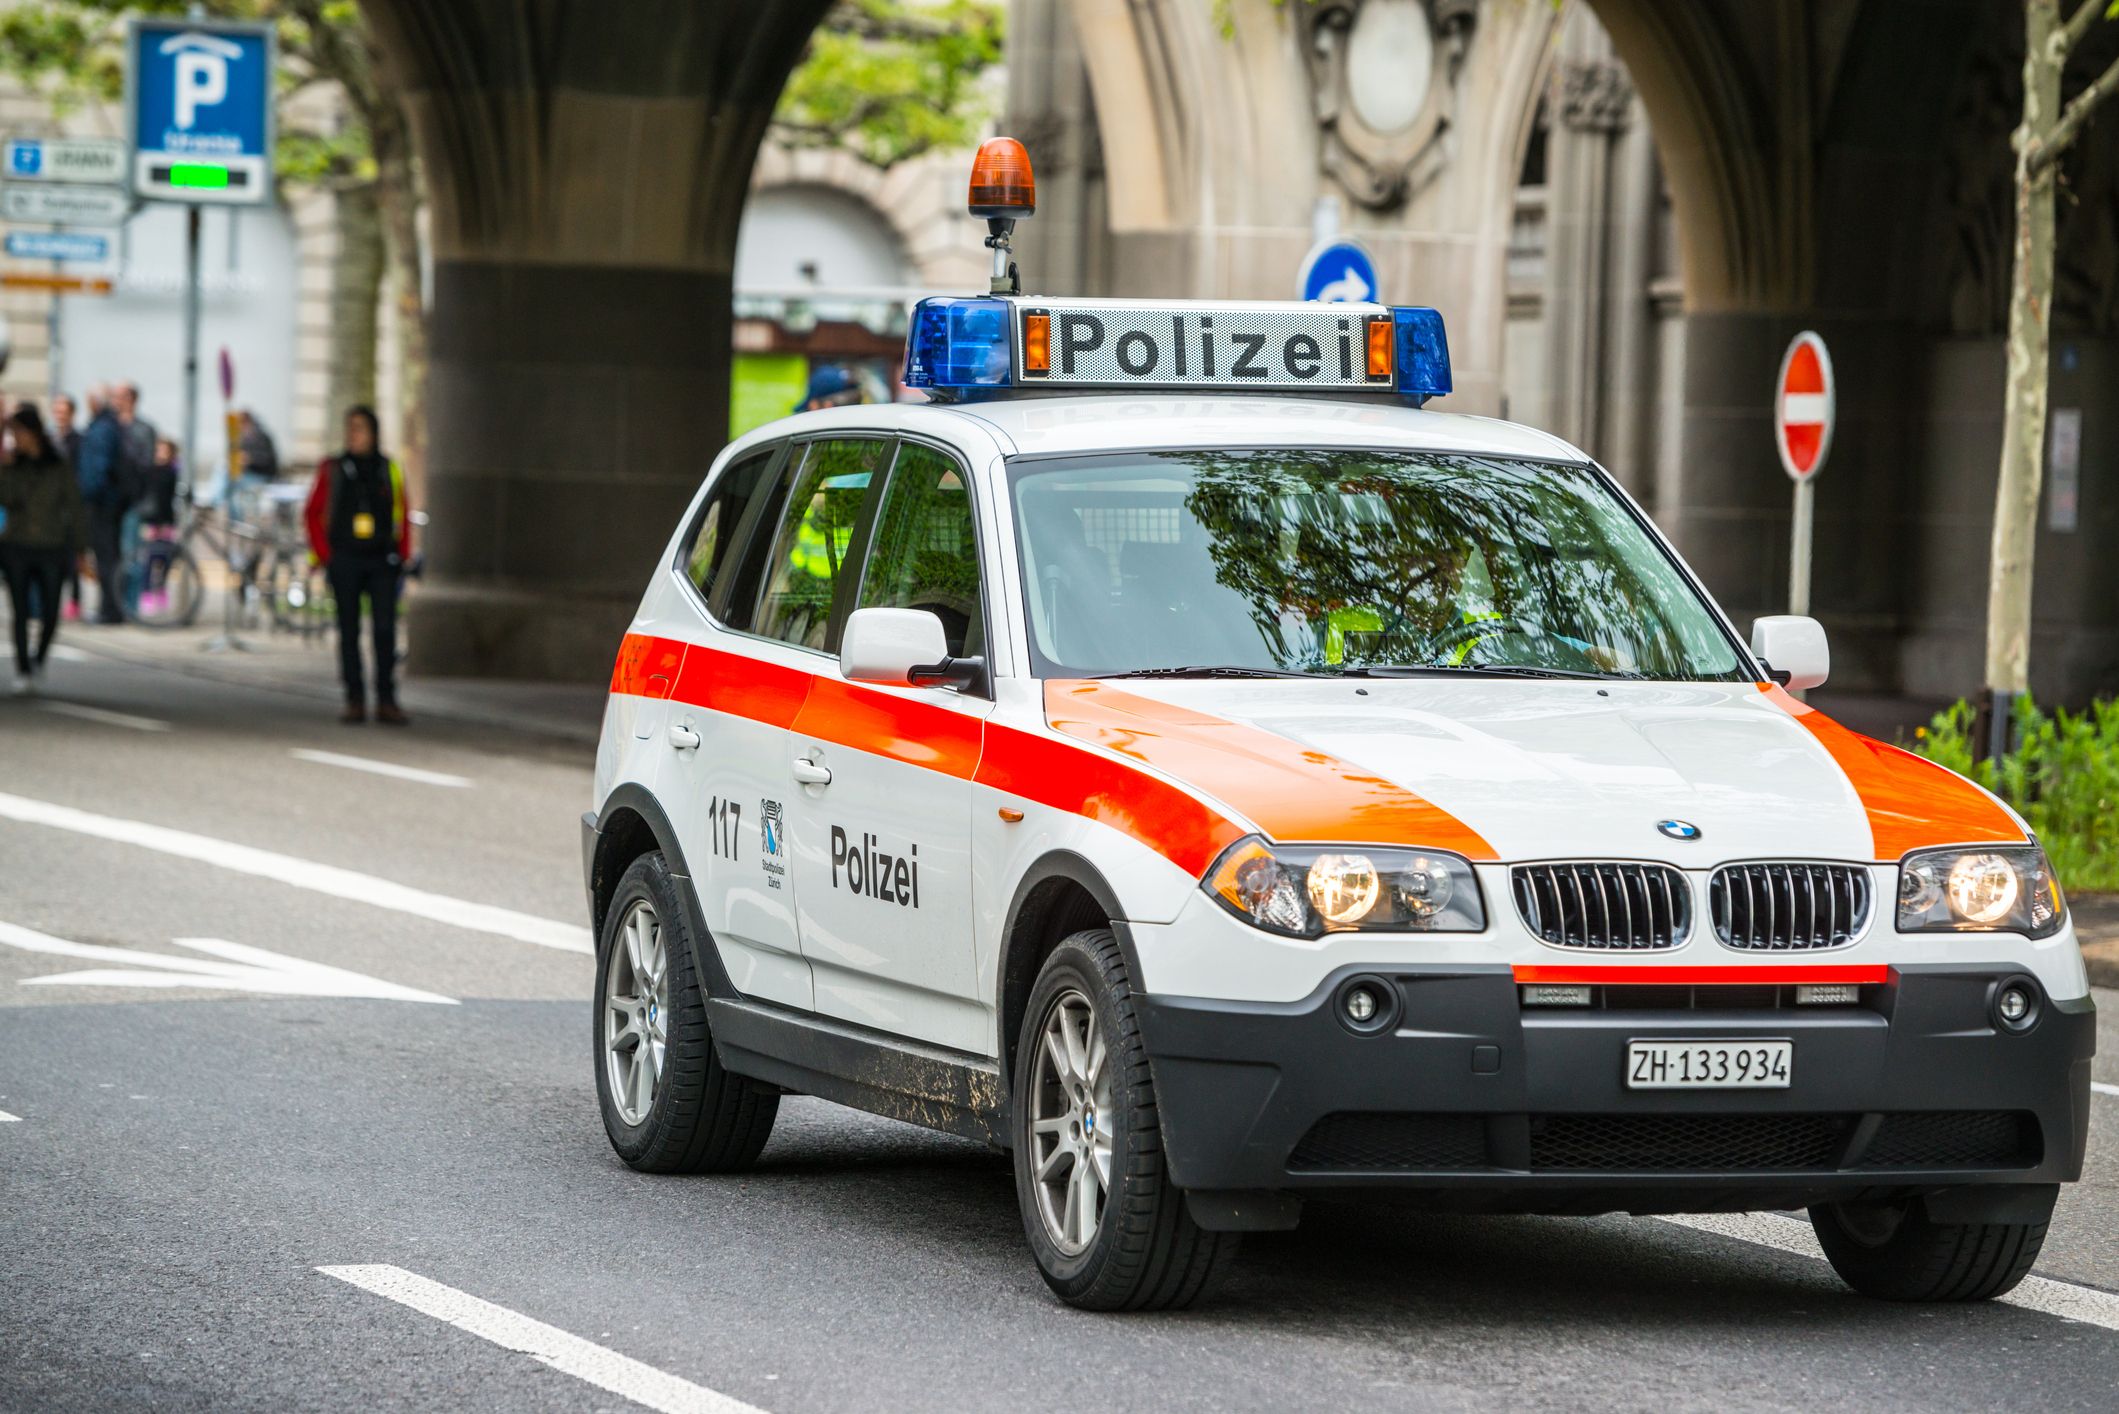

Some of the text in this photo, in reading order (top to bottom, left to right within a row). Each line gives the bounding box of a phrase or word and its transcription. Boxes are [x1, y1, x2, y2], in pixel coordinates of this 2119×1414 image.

[174, 52, 228, 130] P
[1059, 313, 1352, 379] Polizei
[708, 795, 741, 861] 117
[831, 824, 919, 909] Polizei
